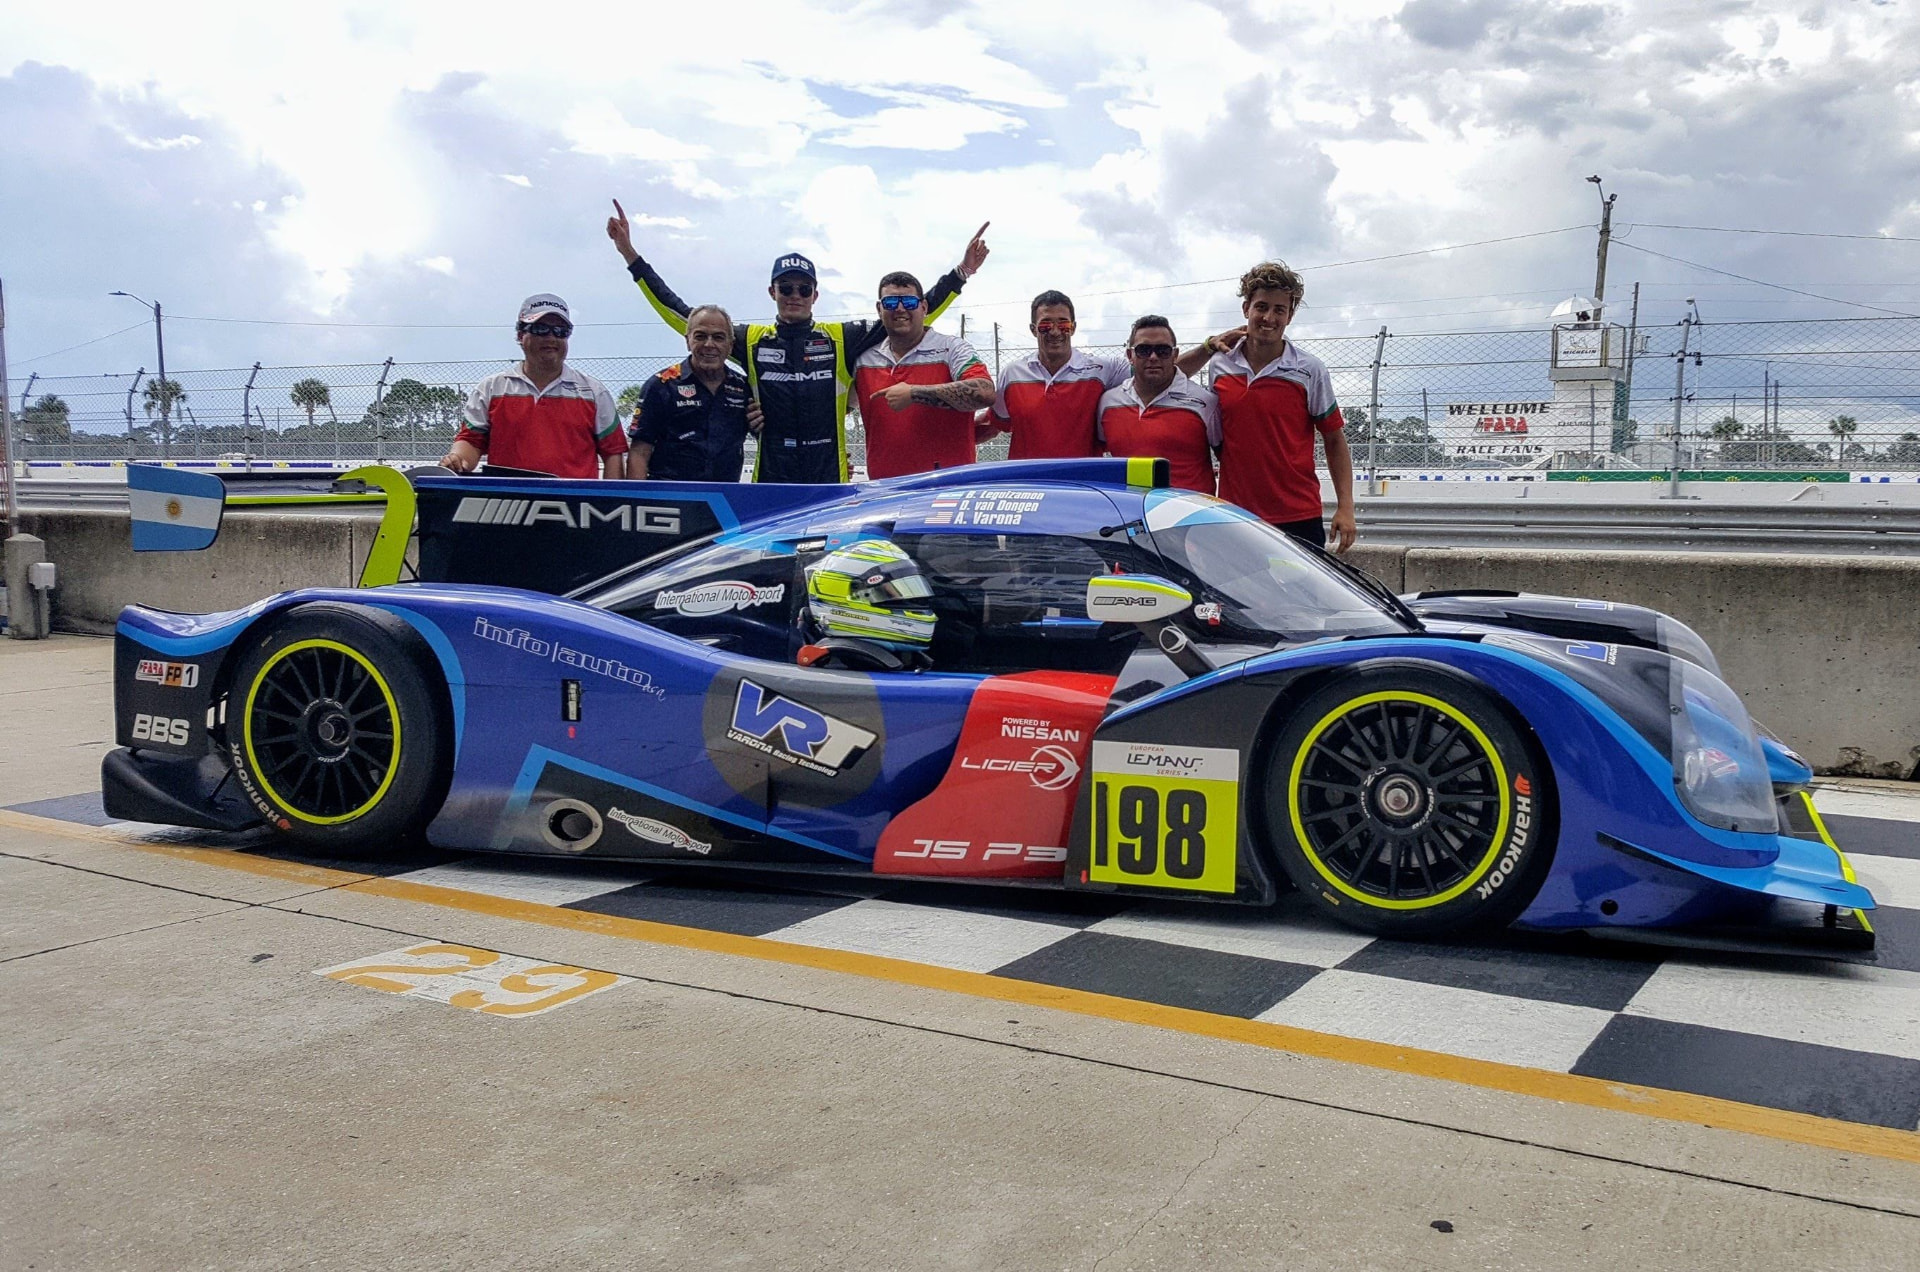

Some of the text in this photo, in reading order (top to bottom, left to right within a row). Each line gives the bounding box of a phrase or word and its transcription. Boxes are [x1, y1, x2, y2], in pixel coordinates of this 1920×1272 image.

[785, 369, 833, 381] AMG
[1449, 402, 1552, 415] WELCOME
[1456, 445, 1543, 454] RACE FANS
[974, 501, 994, 511] van
[997, 500, 1039, 513] Dongen
[523, 500, 680, 534] AMG
[954, 512, 1022, 525] A. Varona
[656, 587, 782, 606] International Motorsport
[1114, 597, 1156, 606] AMG
[186, 666, 194, 685] 1
[132, 713, 190, 745] BBS
[732, 678, 877, 768] VRT
[1002, 717, 1051, 727] POWERED BY
[1001, 724, 1080, 742] NISSAN
[727, 729, 838, 777] VARONA Racing Technology
[961, 757, 1057, 774] LIGIER
[609, 809, 663, 835] International
[1095, 781, 1207, 879] 198
[894, 839, 1067, 862] JS P3
[324, 945, 619, 1014] 29
